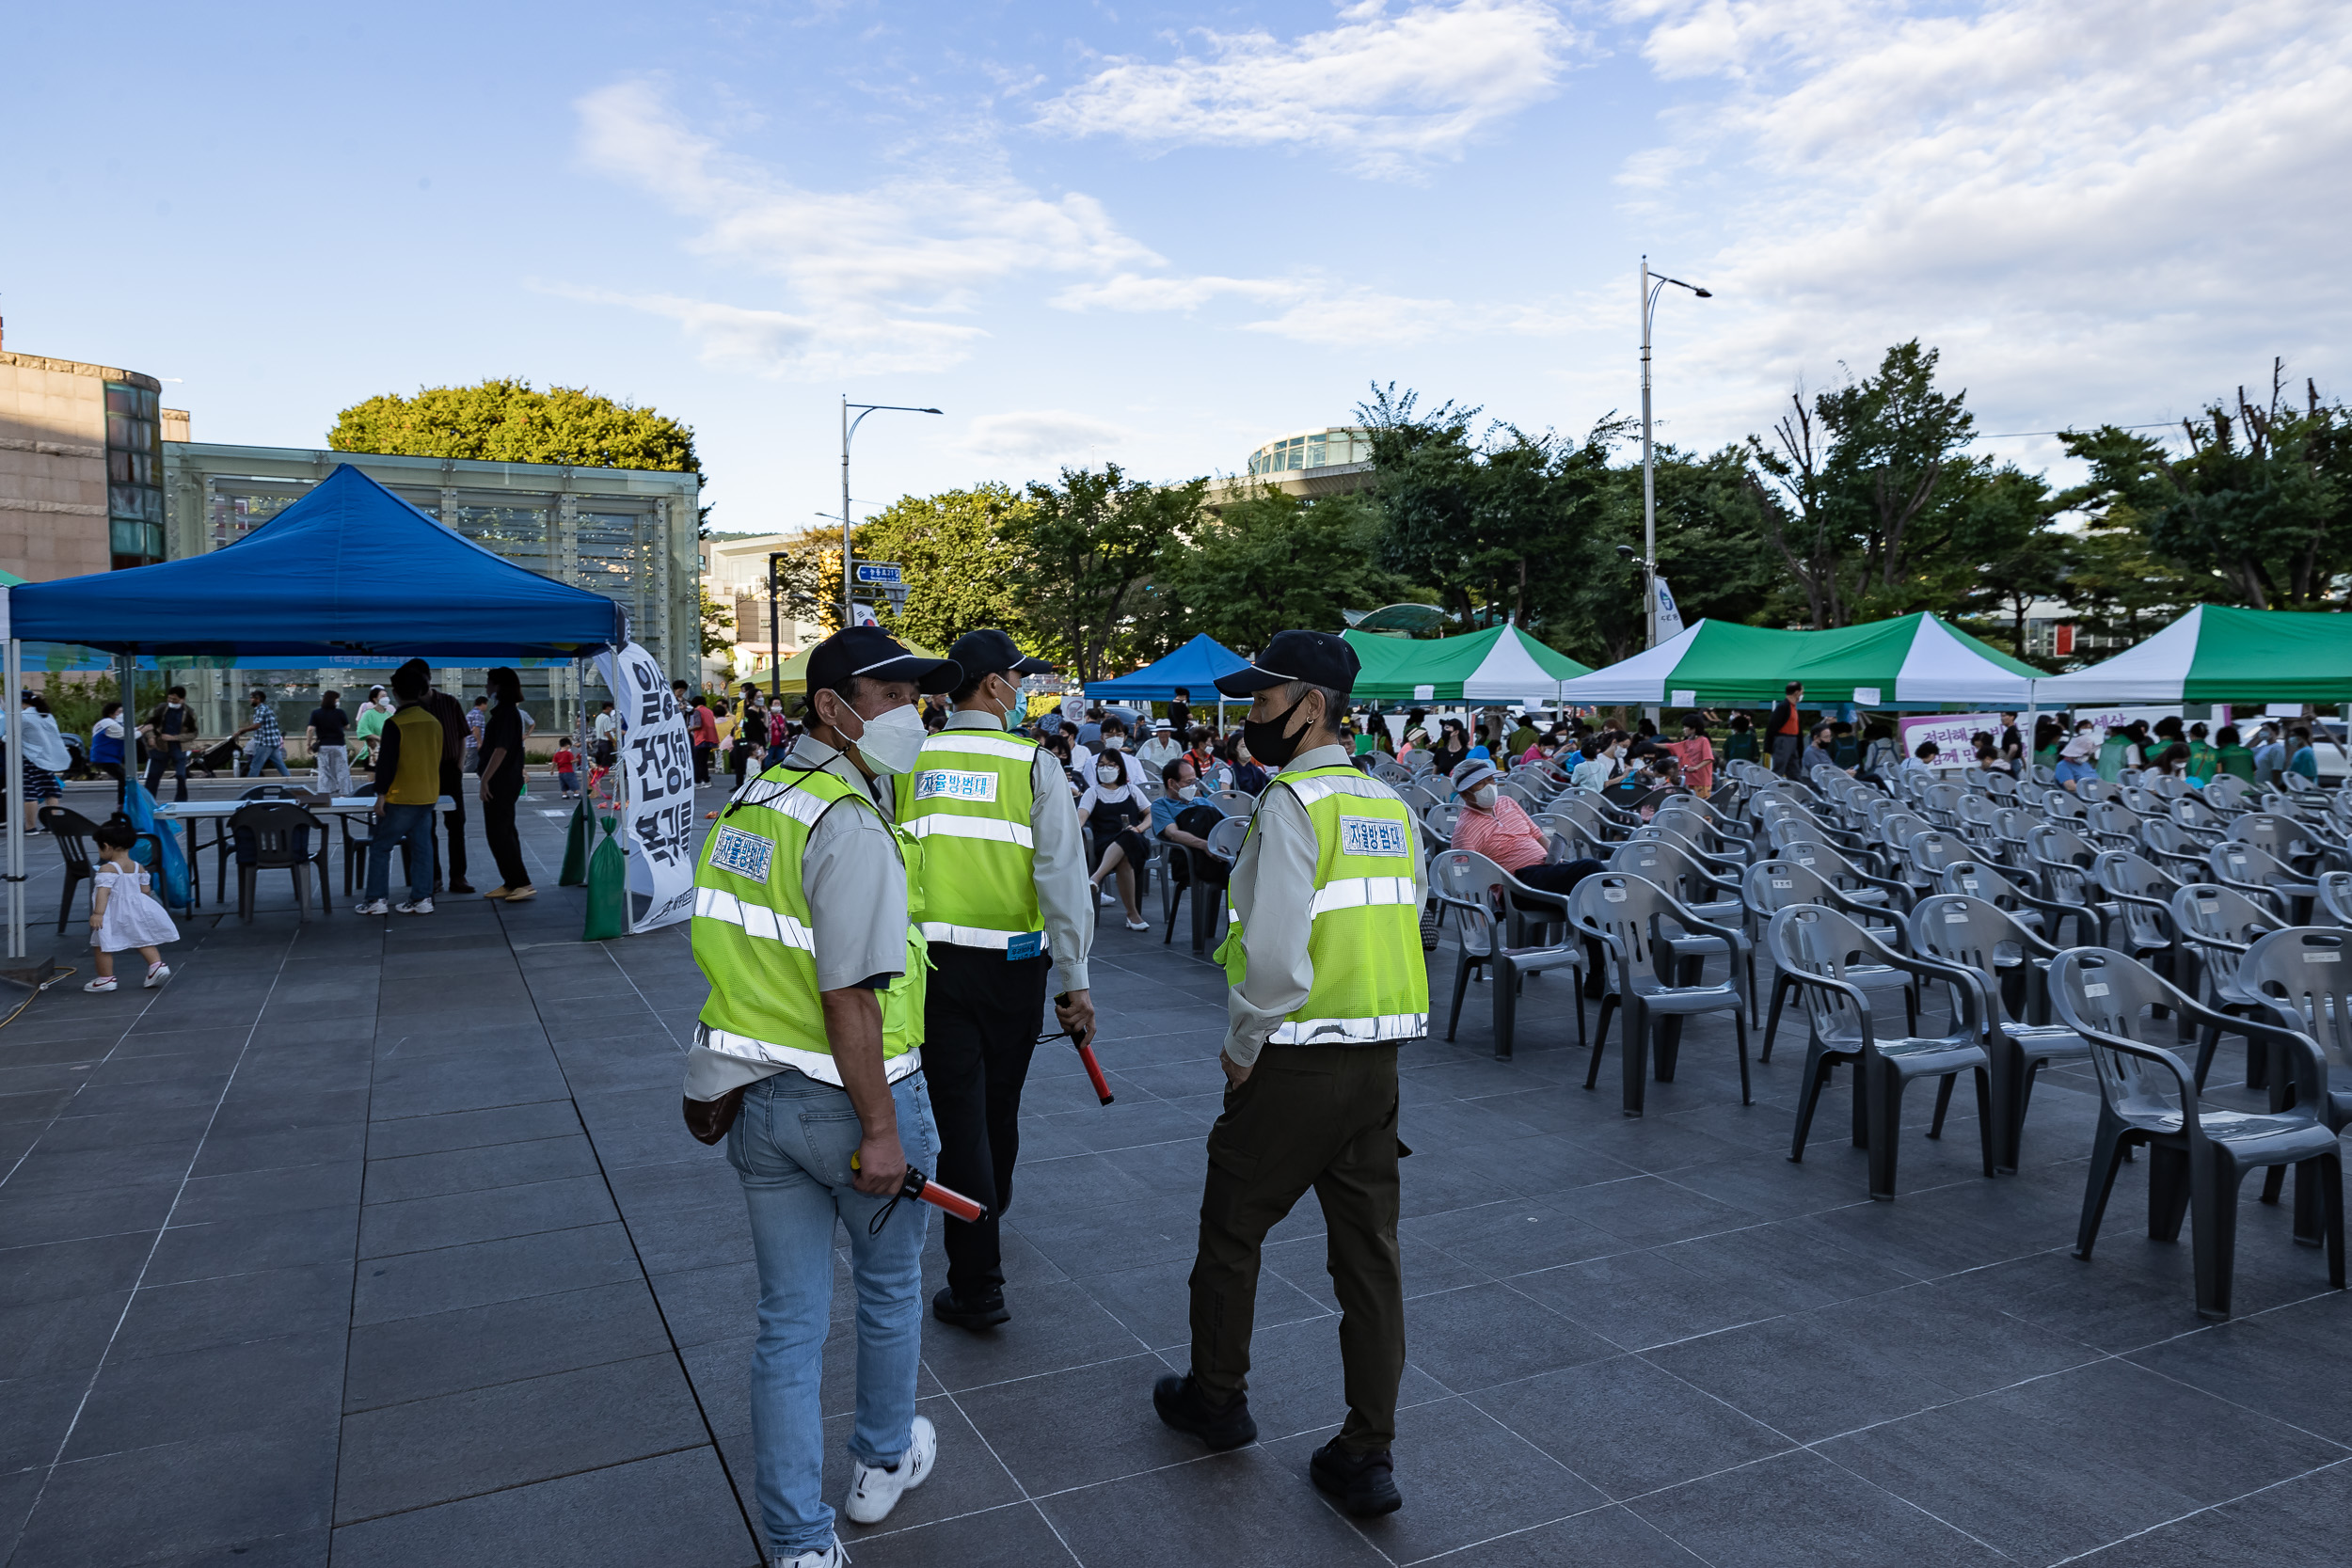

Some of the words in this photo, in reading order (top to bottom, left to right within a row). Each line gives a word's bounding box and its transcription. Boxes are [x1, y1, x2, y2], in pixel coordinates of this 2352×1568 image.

[631, 727, 692, 802] 건강한
[924, 773, 987, 796] 자율방범대
[1349, 822, 1401, 849] 자율방범대
